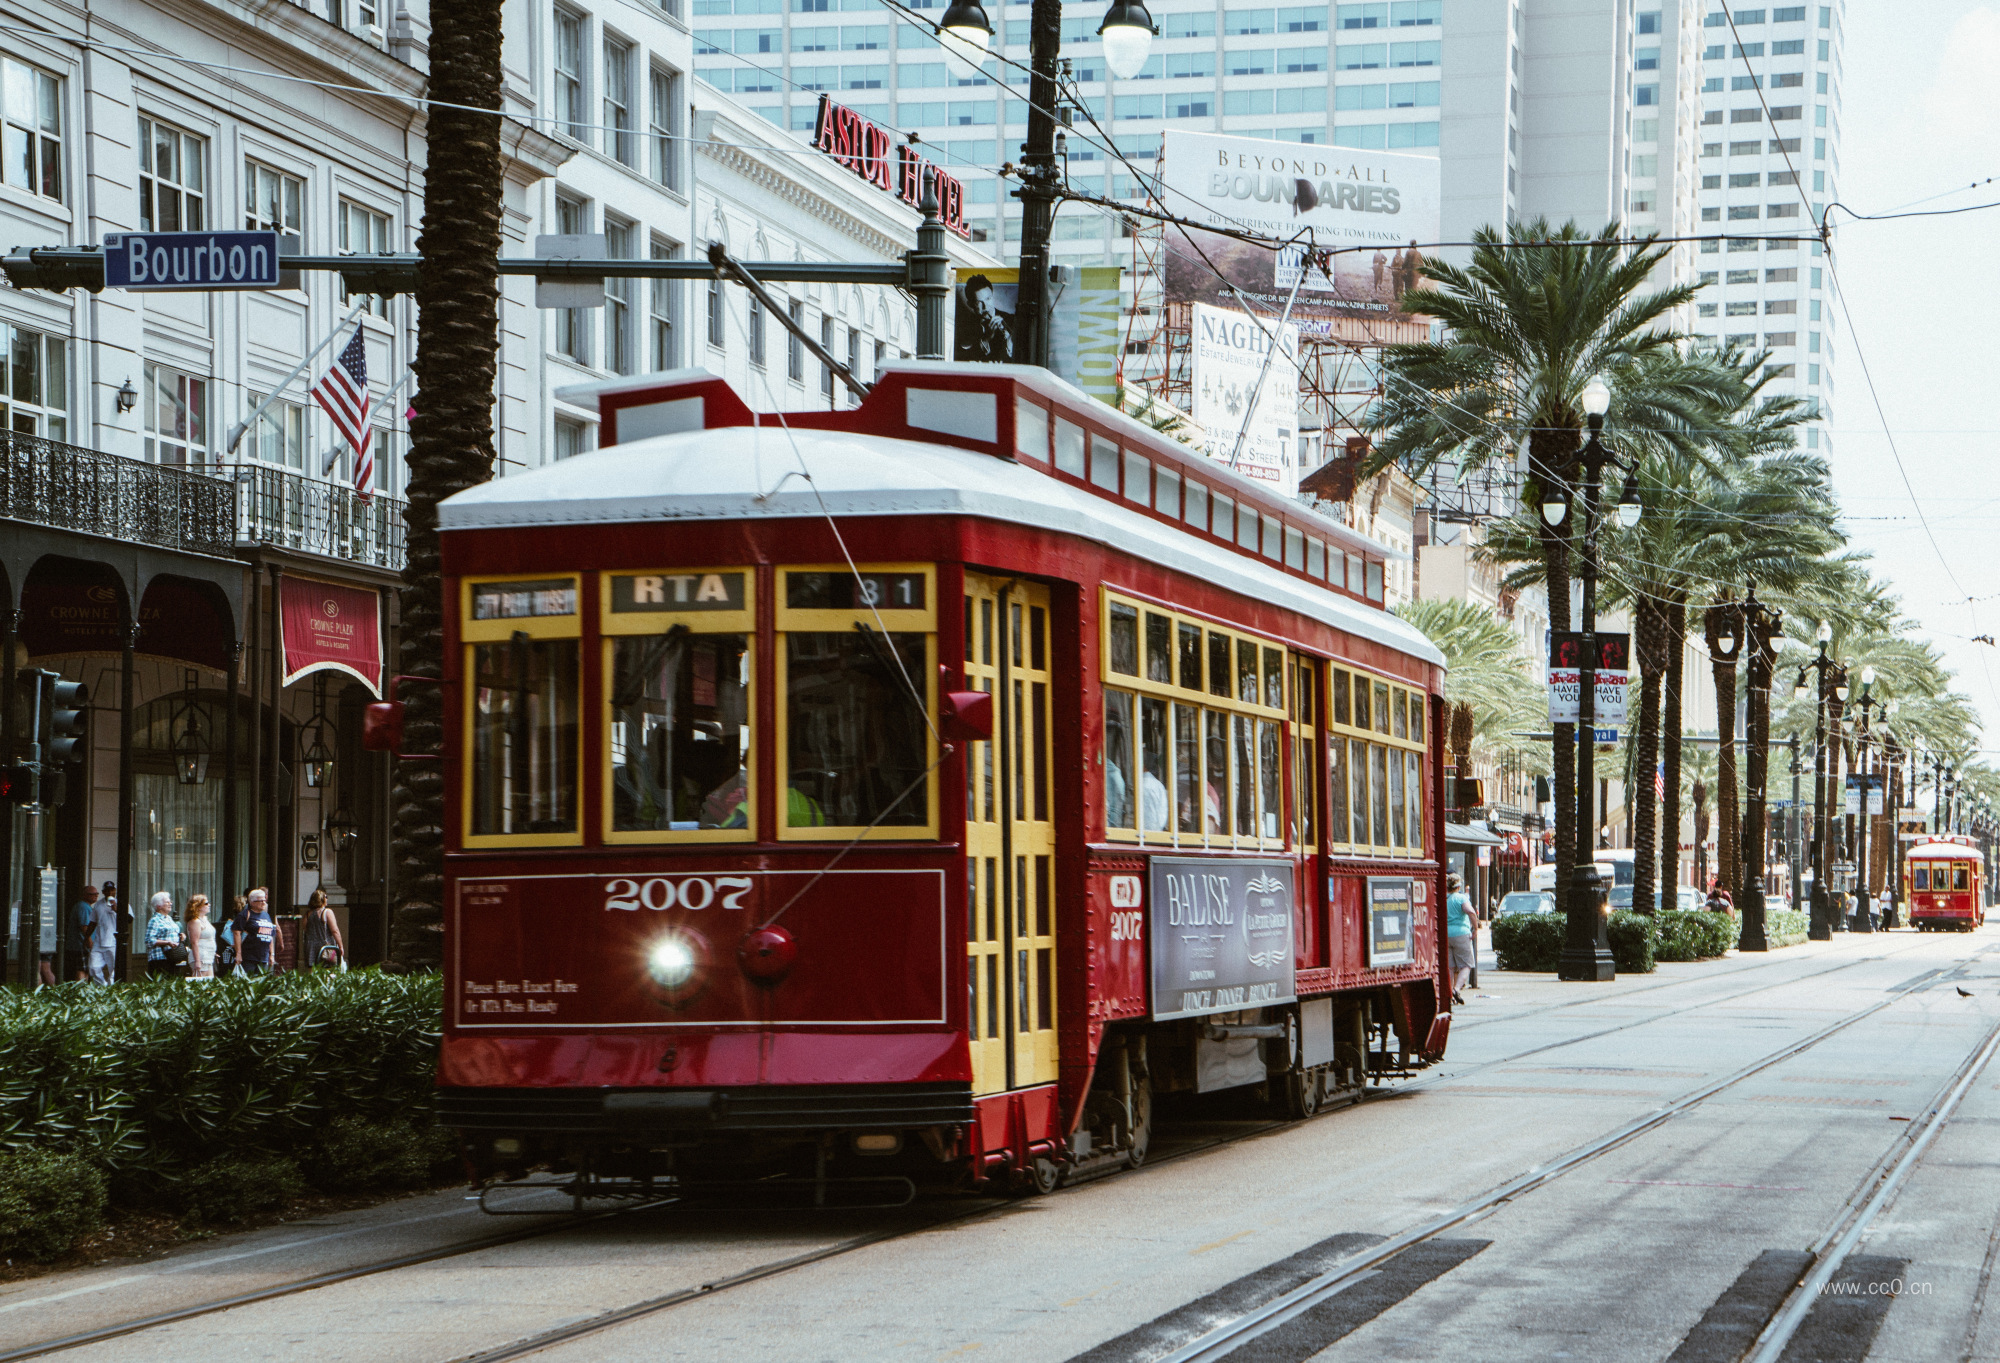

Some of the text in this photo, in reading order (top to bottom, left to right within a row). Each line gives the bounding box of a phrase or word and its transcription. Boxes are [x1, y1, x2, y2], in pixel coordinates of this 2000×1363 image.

[818, 93, 892, 191] ASTOR
[1218, 150, 1390, 184] BEYOND ALL
[1207, 214, 1220, 224] 4D
[1224, 216, 1281, 231] EXPERIENCE
[1345, 229, 1364, 239] TOM
[1368, 231, 1401, 242] HANKS
[129, 236, 268, 282] Bourbon
[1278, 296, 1304, 304] BETEEN
[1305, 298, 1322, 306] CAMP
[1322, 299, 1335, 307] AND
[1366, 303, 1389, 312] STREETS
[1201, 314, 1293, 358] NAGHIS
[1200, 344, 1224, 359] ESTATE
[1225, 347, 1255, 367] JEWELRY
[1256, 358, 1261, 369] &
[1249, 447, 1278, 465] STREET
[633, 574, 729, 603] RTA
[51, 606, 110, 619] CROWNE
[311, 618, 354, 635] CROWNE PLAZA
[1553, 685, 1579, 694] HAVE
[1558, 694, 1580, 702] YOU
[1595, 686, 1621, 695] HAVE
[1600, 694, 1622, 704] YOU
[1594, 730, 1611, 740] yal
[605, 877, 752, 911] 2007
[1166, 873, 1234, 927] BALISE
[1110, 911, 1142, 941] 2007
